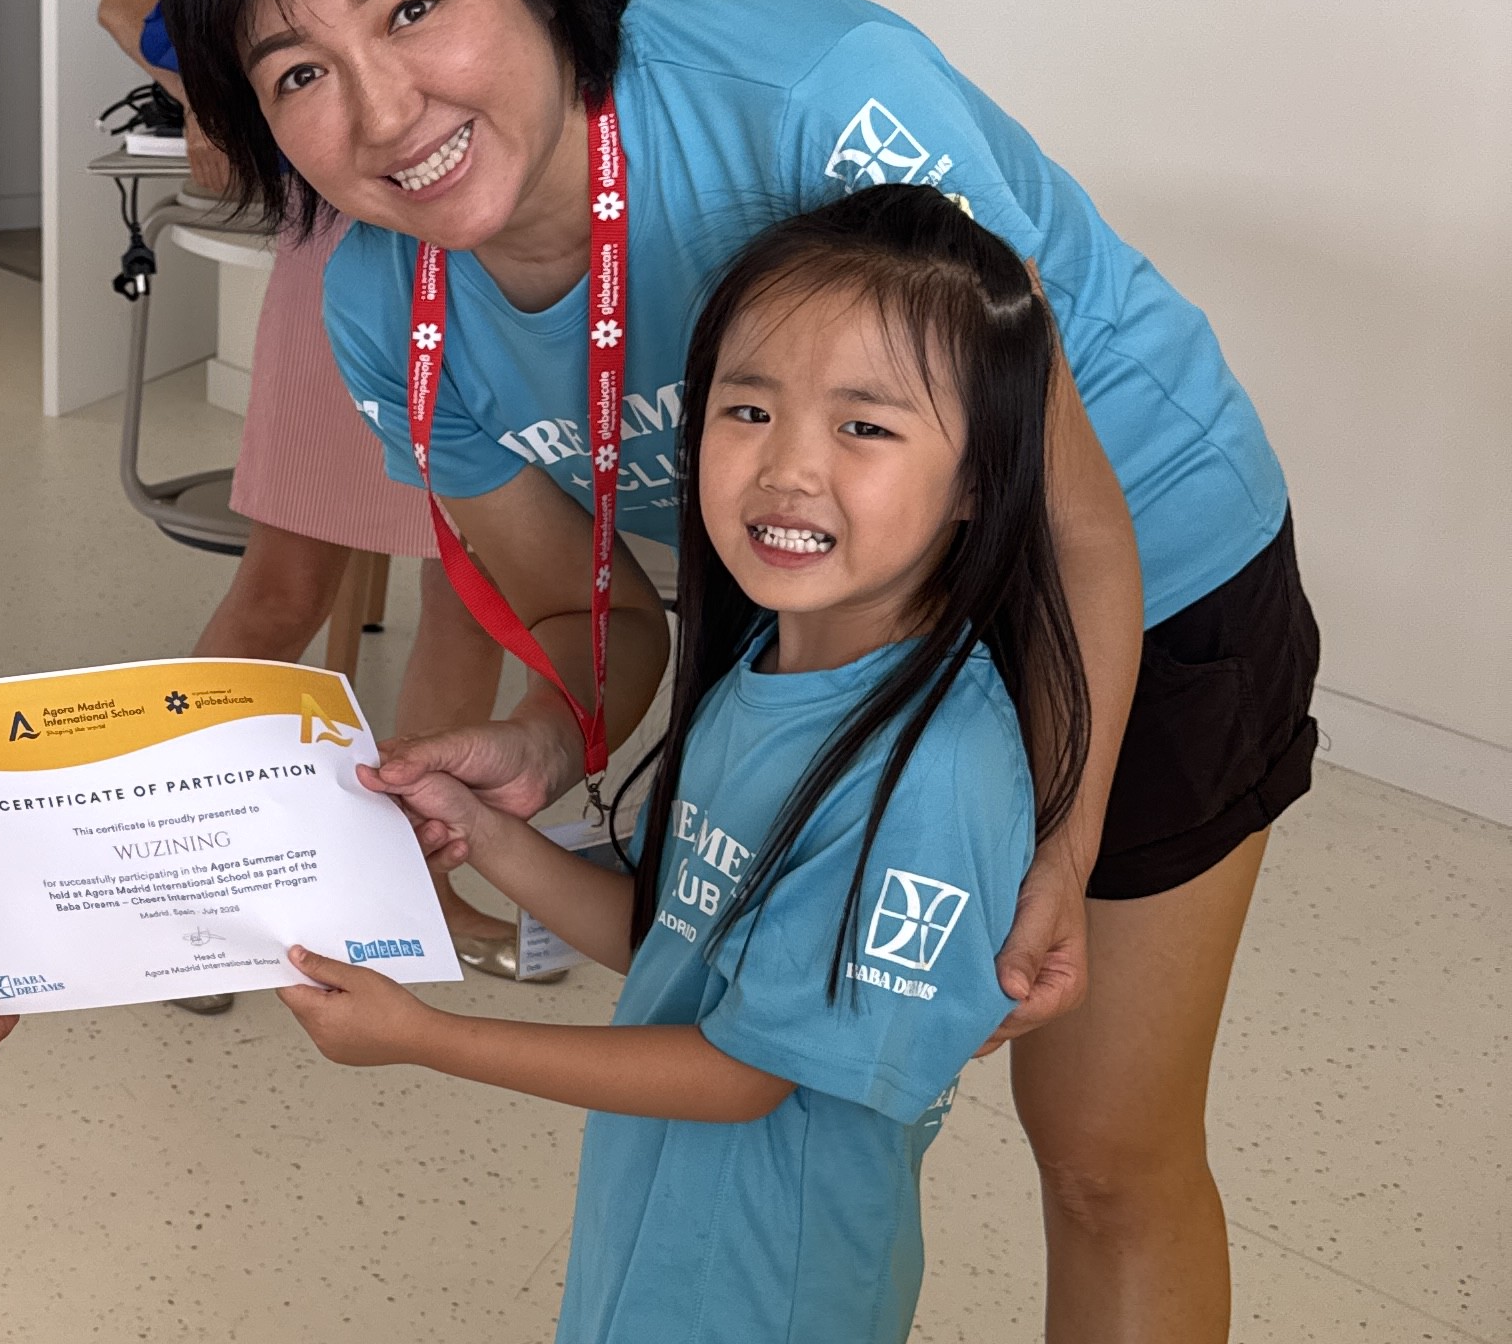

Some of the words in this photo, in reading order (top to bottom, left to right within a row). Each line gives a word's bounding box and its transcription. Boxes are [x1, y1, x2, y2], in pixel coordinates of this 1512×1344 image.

[597, 114, 615, 187] globeducate
[597, 244, 614, 315] globeducate
[417, 354, 434, 421] globeducate
[597, 371, 612, 440] globeducate
[42, 707, 74, 717] Agora
[78, 699, 115, 712] Madrid
[43, 711, 108, 727] International
[110, 706, 145, 718] School
[195, 695, 254, 709] globeducate
[133, 784, 157, 797] OF
[166, 763, 317, 793] PARTICIPATION
[72, 827, 94, 837] This
[96, 823, 146, 834] certificate
[148, 819, 156, 827] is
[158, 813, 195, 828] proudly
[198, 805, 247, 822] presented
[249, 805, 260, 813] to
[112, 830, 231, 861] WUZINING
[43, 879, 56, 888] for
[59, 874, 116, 887] successfully
[119, 869, 179, 883] participating
[180, 867, 190, 875] in
[192, 865, 207, 874] the
[210, 861, 240, 872] Agora
[242, 853, 284, 866] Summer
[286, 849, 317, 860] Camp
[49, 890, 70, 900] held
[73, 890, 83, 898] at
[85, 889, 114, 898] Agora
[116, 884, 151, 895] Madrid
[153, 876, 215, 892] International
[217, 871, 251, 884] School
[266, 866, 286, 877] part
[288, 862, 299, 872] of
[300, 861, 317, 870] the
[56, 903, 81, 912] Baba
[82, 900, 120, 910] Dreams
[131, 895, 166, 905] Cheers
[168, 887, 229, 901] International
[230, 882, 272, 895] Summer
[274, 875, 317, 887] Program
[194, 953, 216, 961] Head
[347, 941, 423, 961] CHEERS
[13, 974, 47, 986] BABA
[145, 969, 170, 978] Agora
[171, 964, 200, 974] Madrid
[202, 960, 252, 970] International
[15, 982, 66, 995] DREAMS
